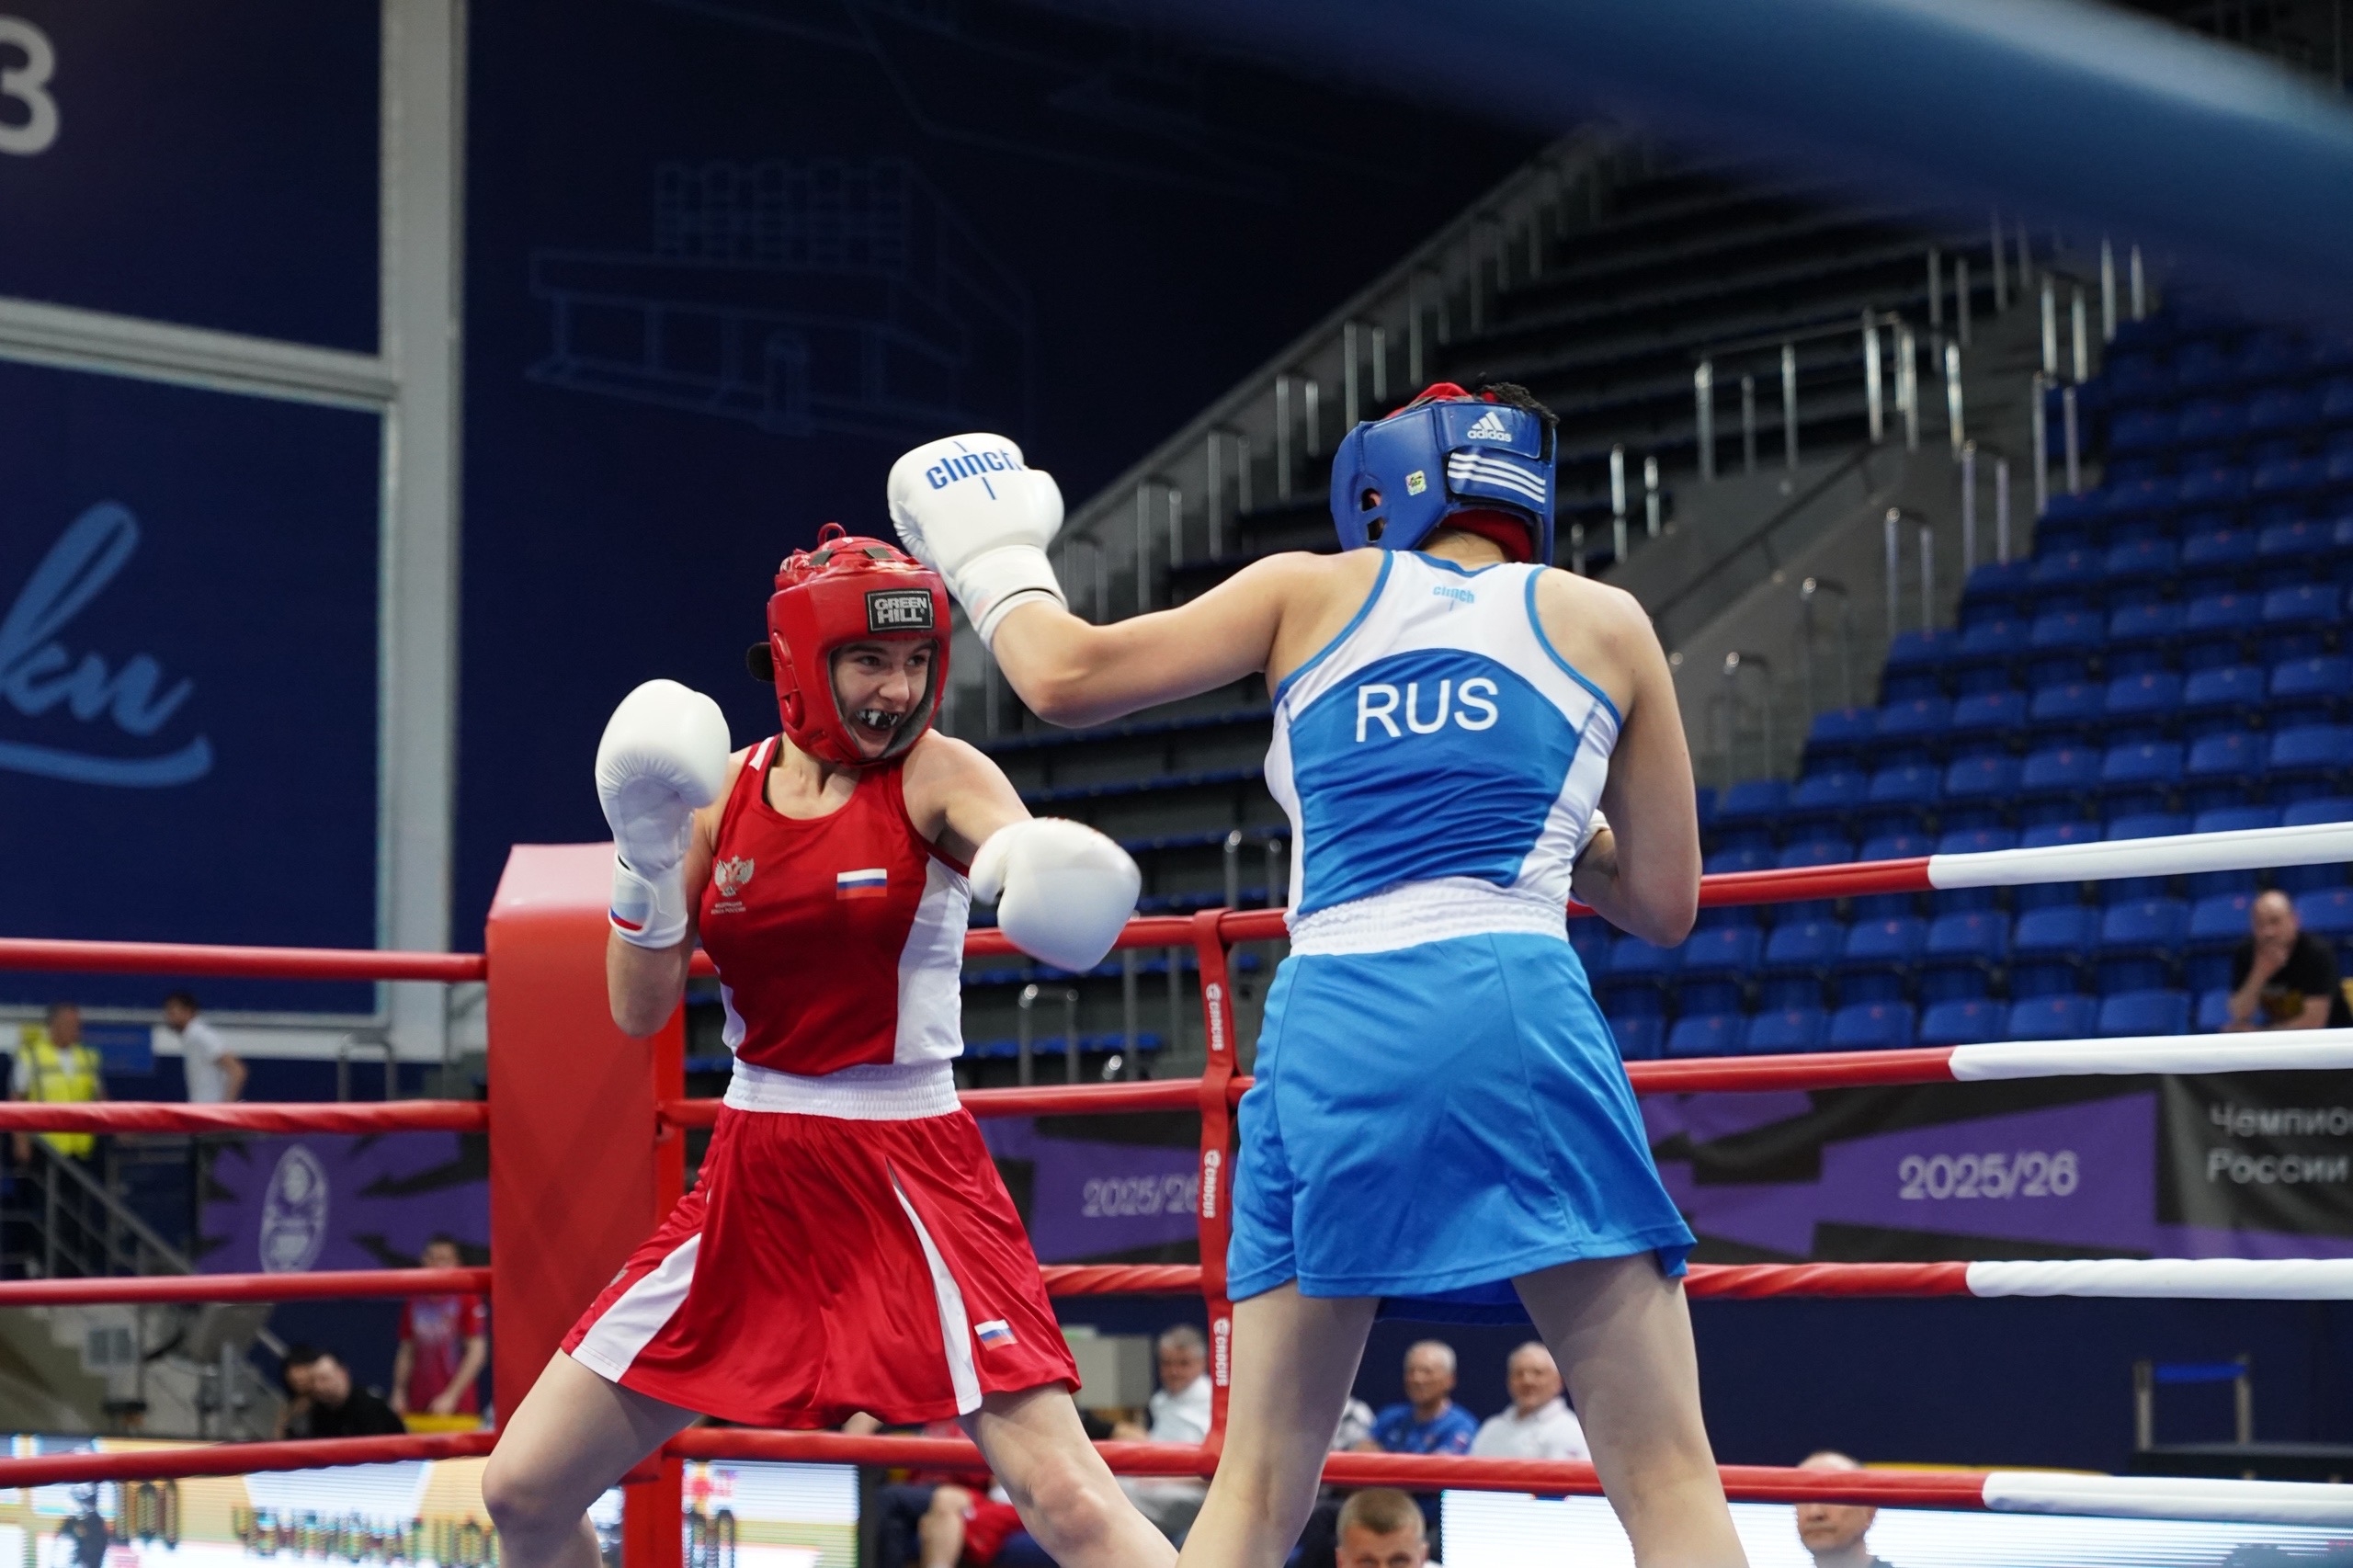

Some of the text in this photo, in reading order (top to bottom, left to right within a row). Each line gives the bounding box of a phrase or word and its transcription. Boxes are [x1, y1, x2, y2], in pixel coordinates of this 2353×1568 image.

[1467, 429, 1512, 442] adidas
[874, 597, 927, 610] GREEN
[1433, 585, 1475, 604] clinch
[877, 608, 923, 624] HILL
[1356, 677, 1499, 743] RUS
[1209, 1001, 1224, 1051] CROCUS
[2210, 1102, 2353, 1137] Чемпио
[1899, 1151, 2079, 1199] 2025/26
[2208, 1148, 2349, 1184] России
[1202, 1167, 1217, 1218] CROCUS
[1215, 1335, 1230, 1386] CROCUS
